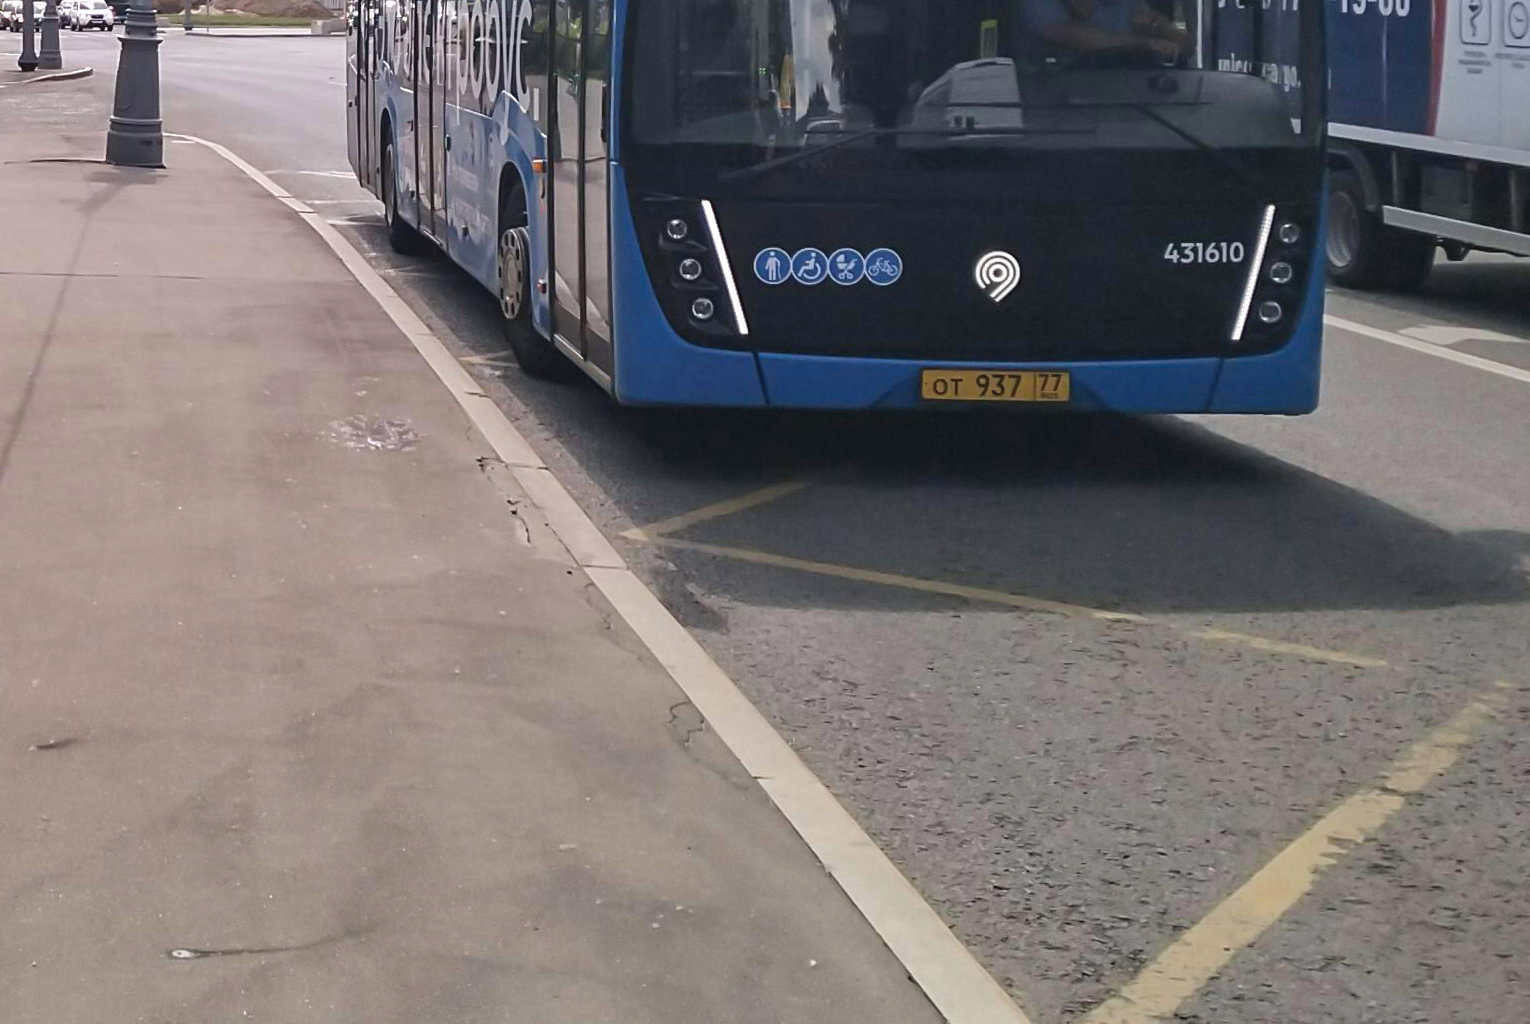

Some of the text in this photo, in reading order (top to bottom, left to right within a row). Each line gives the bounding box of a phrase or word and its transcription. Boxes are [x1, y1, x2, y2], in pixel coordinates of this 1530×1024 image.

[1164, 241, 1245, 263] 431610
[932, 374, 1062, 398] ОТ 937 77
